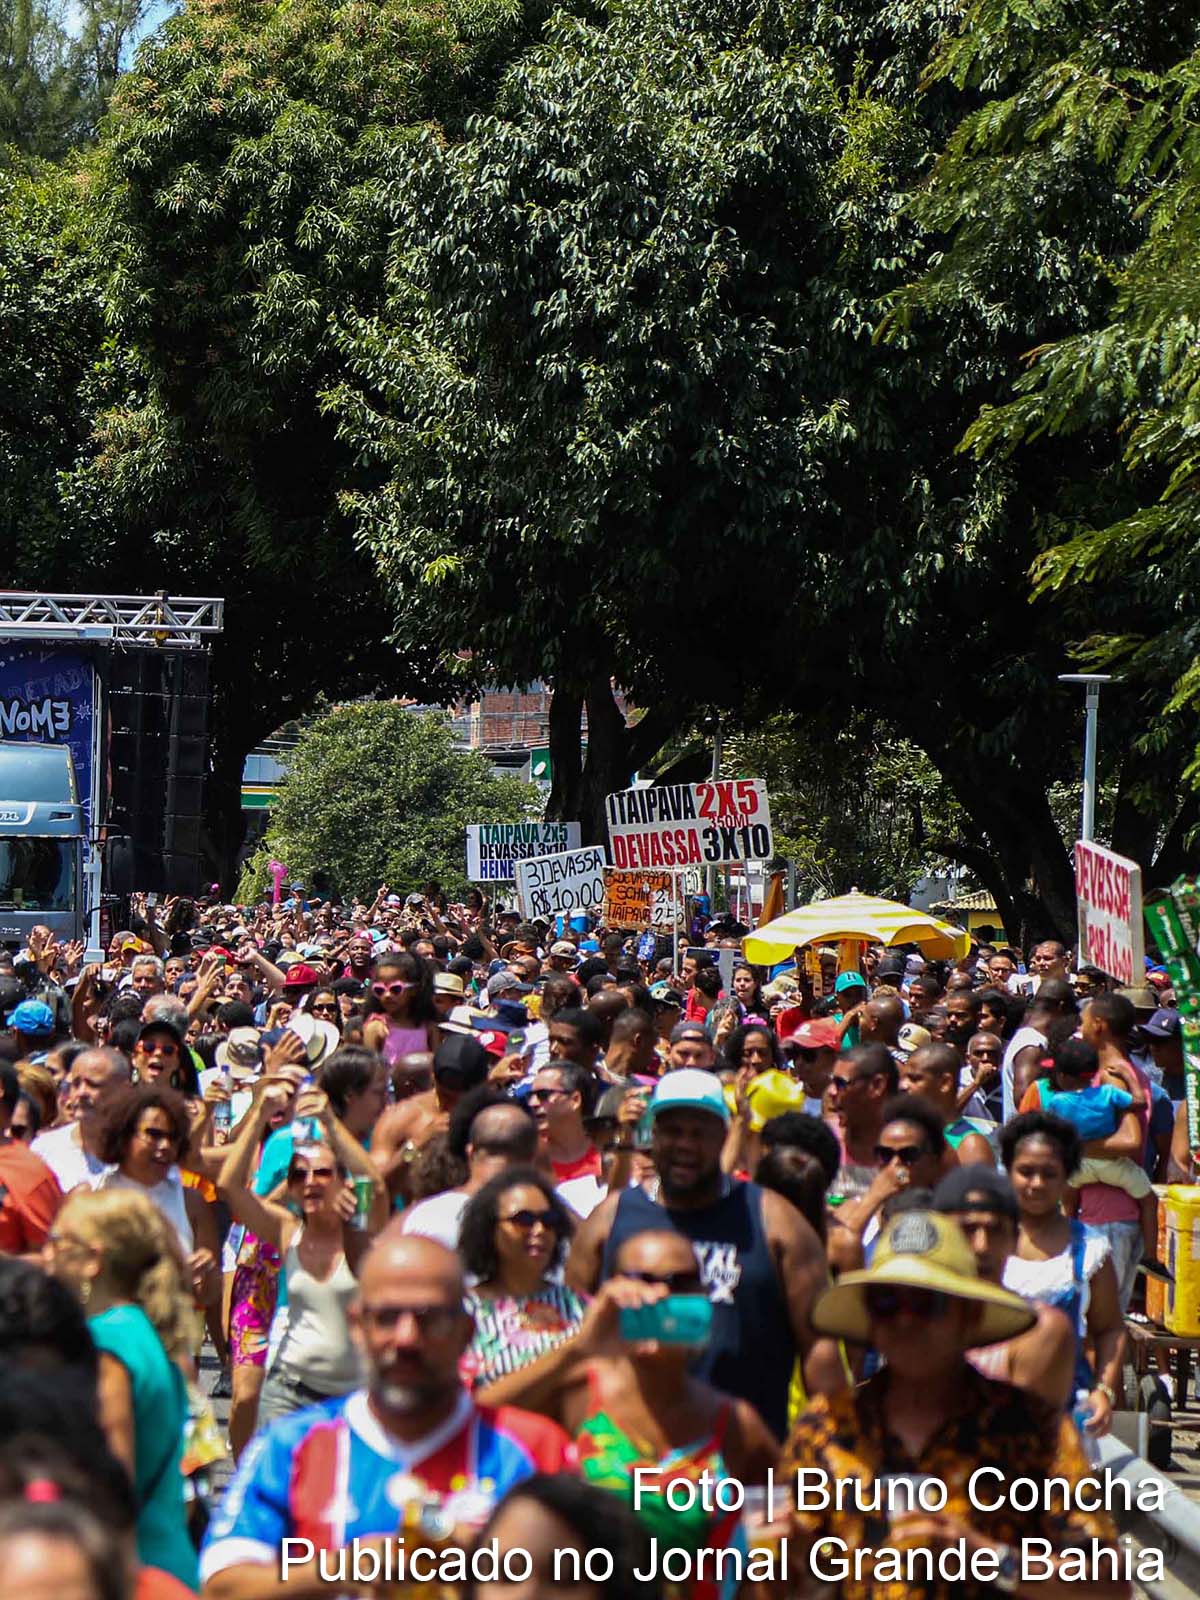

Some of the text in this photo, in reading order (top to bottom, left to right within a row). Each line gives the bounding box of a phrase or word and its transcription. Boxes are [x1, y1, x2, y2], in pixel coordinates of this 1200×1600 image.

[608, 785, 696, 826] ITAIPAVA
[480, 823, 539, 844] ITAIPAVA
[613, 823, 771, 869] DEVASSA 3X10
[480, 843, 535, 860] DEVASSA
[480, 860, 515, 879] HEINE
[539, 849, 604, 886] DEVASSA
